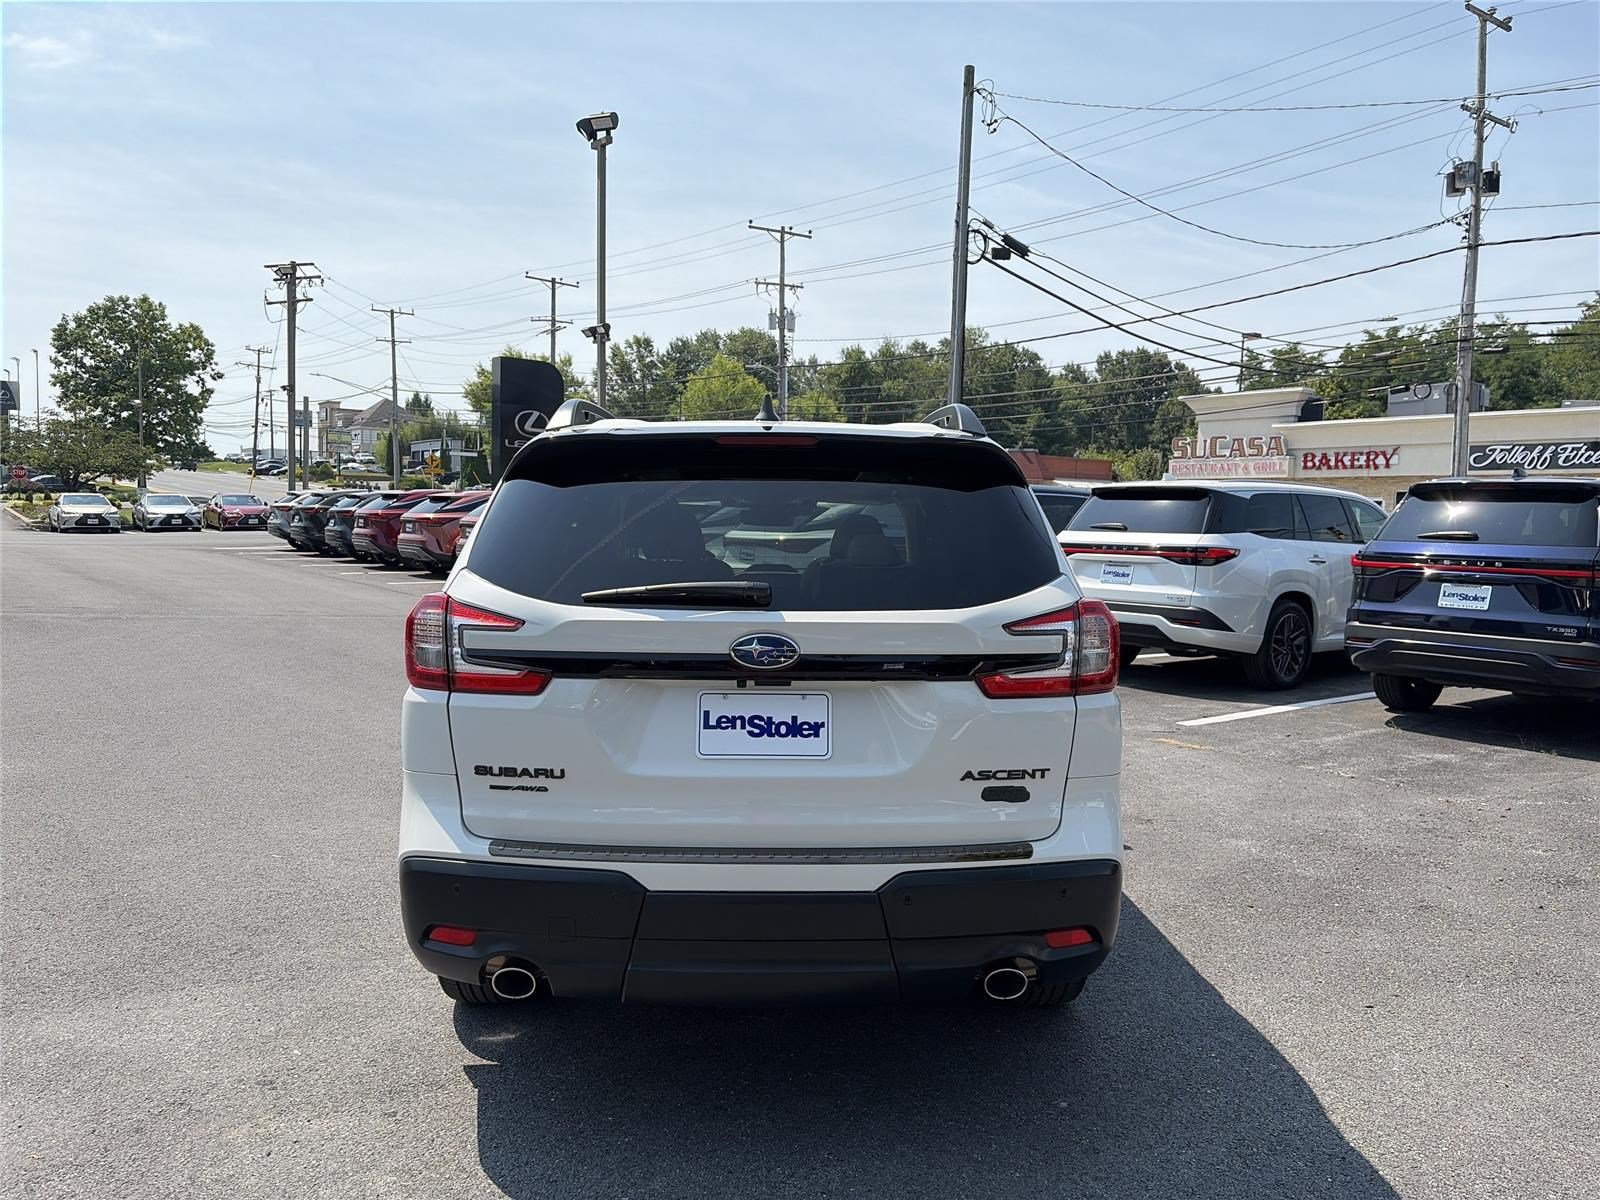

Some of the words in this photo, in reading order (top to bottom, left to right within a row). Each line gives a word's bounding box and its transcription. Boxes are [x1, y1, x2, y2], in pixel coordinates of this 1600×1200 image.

[1301, 446, 1400, 471] BAKERY
[1171, 462, 1240, 475] RESTAURANT
[1252, 461, 1285, 473] GRILL
[1427, 558, 1503, 568] LEXUS
[473, 764, 566, 780] SUBARU
[959, 767, 1051, 782] ASCENT
